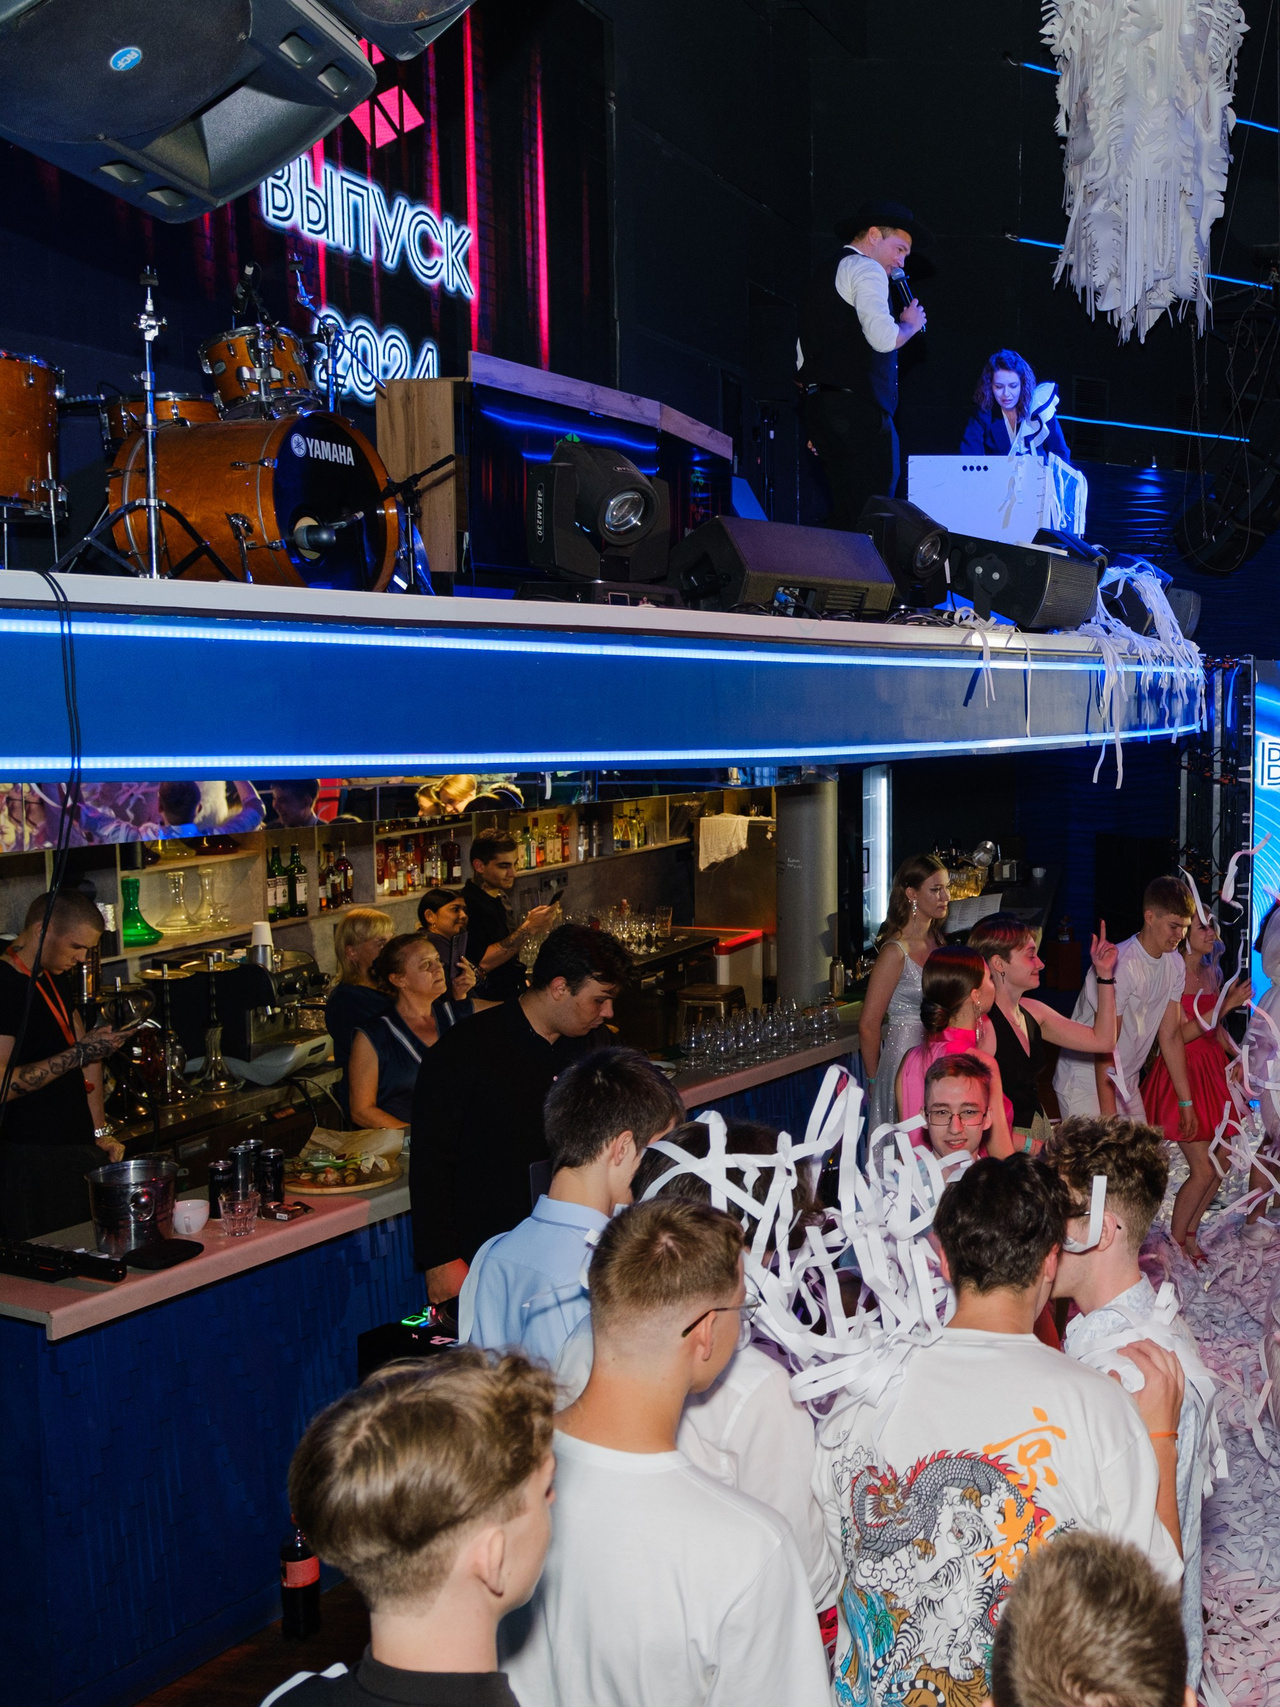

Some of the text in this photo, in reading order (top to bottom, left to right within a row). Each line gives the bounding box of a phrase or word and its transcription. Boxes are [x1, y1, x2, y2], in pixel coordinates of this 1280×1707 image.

[117, 50, 139, 69] RCF
[263, 157, 474, 296] ВЫПУСК
[305, 436, 355, 467] YAMAHA
